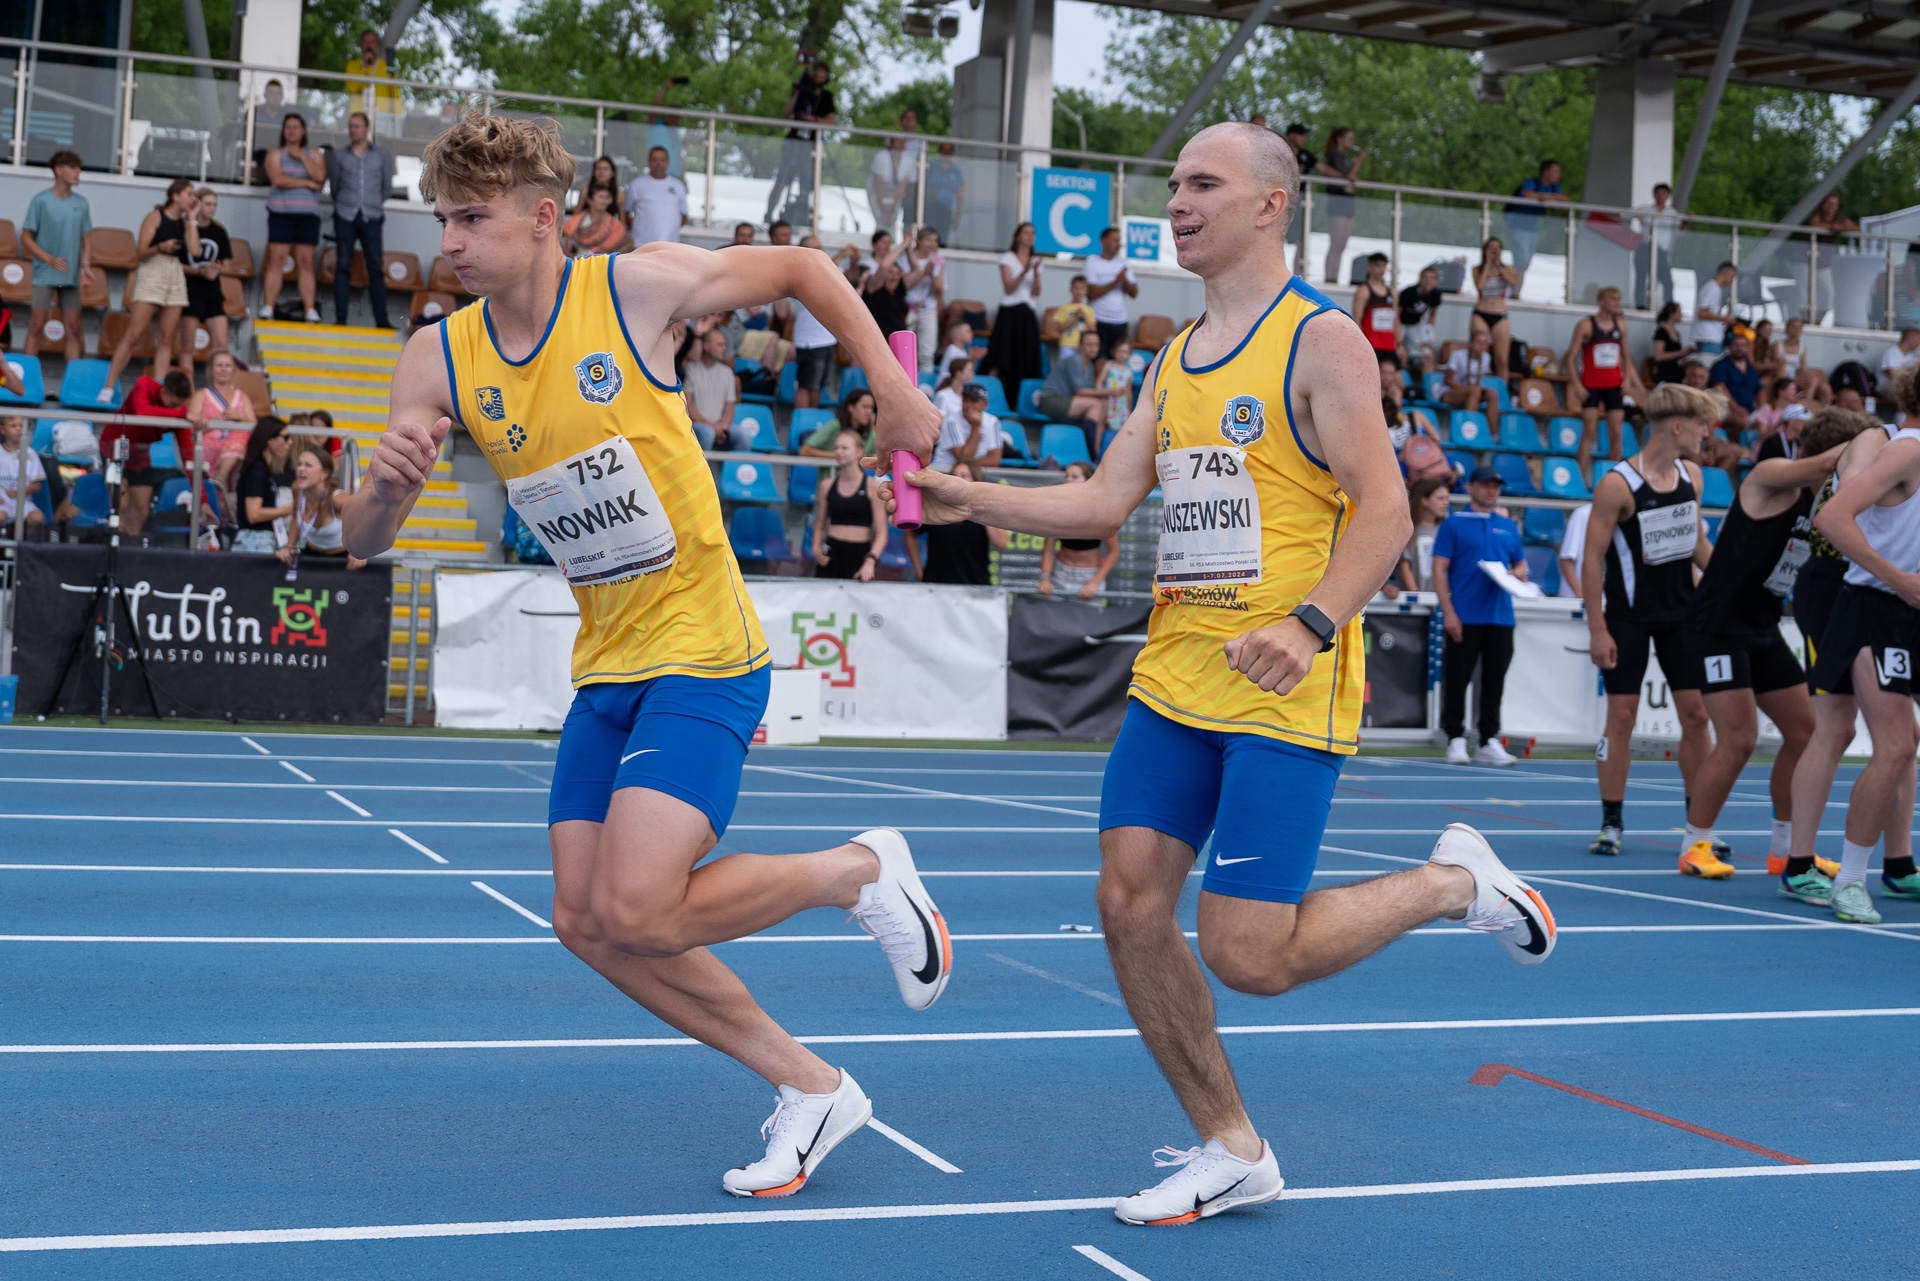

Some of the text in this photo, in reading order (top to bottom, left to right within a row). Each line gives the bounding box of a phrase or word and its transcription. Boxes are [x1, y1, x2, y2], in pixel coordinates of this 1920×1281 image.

[1046, 174, 1096, 191] SEKTOR
[1049, 192, 1092, 249] C
[1128, 225, 1159, 246] WC
[593, 366, 603, 378] S
[1239, 408, 1248, 420] S
[567, 447, 624, 486] 752
[1189, 452, 1239, 480] 743
[537, 488, 649, 545] NOWAK
[1161, 497, 1251, 534] NUSZEWSKI
[1672, 505, 1692, 518] 687
[569, 550, 606, 566] LUBELSKIE
[1162, 552, 1184, 561] LUBELSKIE
[573, 563, 591, 574] 2024
[1203, 571, 1246, 579] 5-7.07.2024
[127, 648, 328, 669] MIASTO INSPIRACJI
[1712, 657, 1723, 679] 1
[1892, 652, 1906, 675] 3
